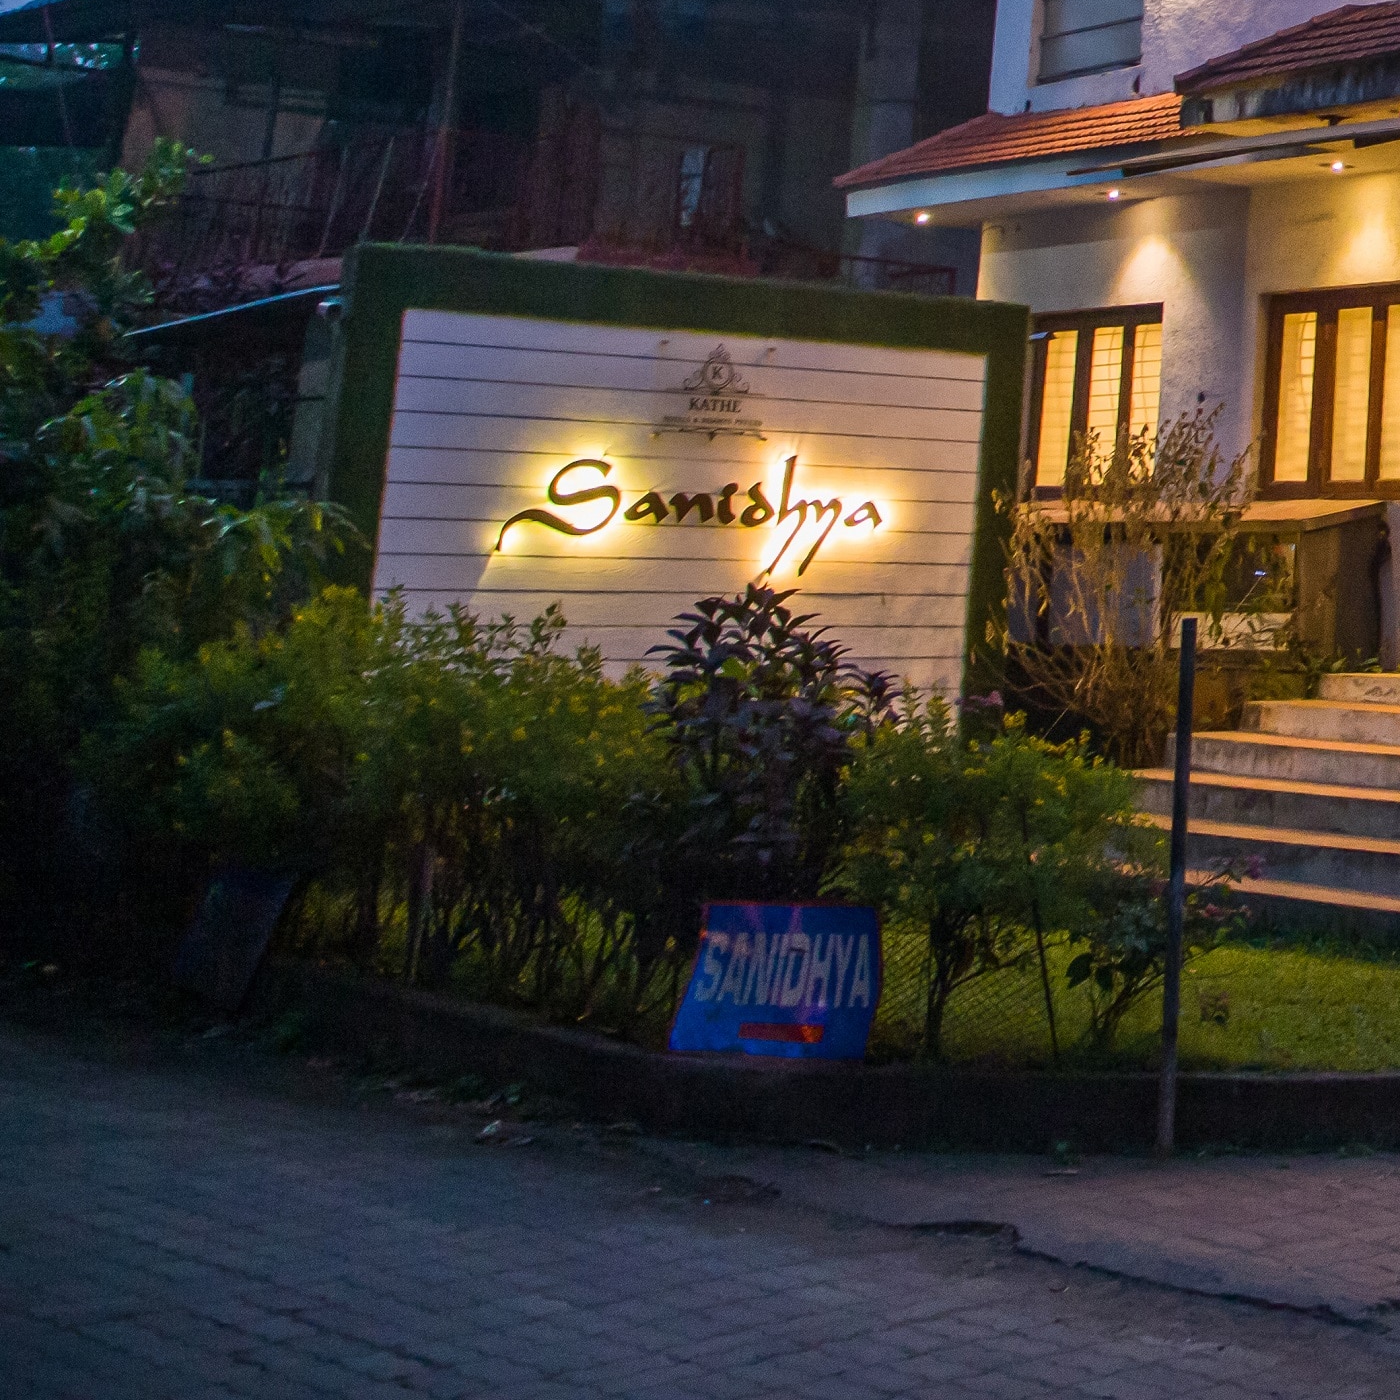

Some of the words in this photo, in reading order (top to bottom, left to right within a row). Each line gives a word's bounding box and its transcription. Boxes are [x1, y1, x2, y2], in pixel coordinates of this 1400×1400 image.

[688, 398, 741, 413] KATHE
[495, 455, 883, 578] Sanidhya
[693, 931, 871, 1008] SANIDHYA
